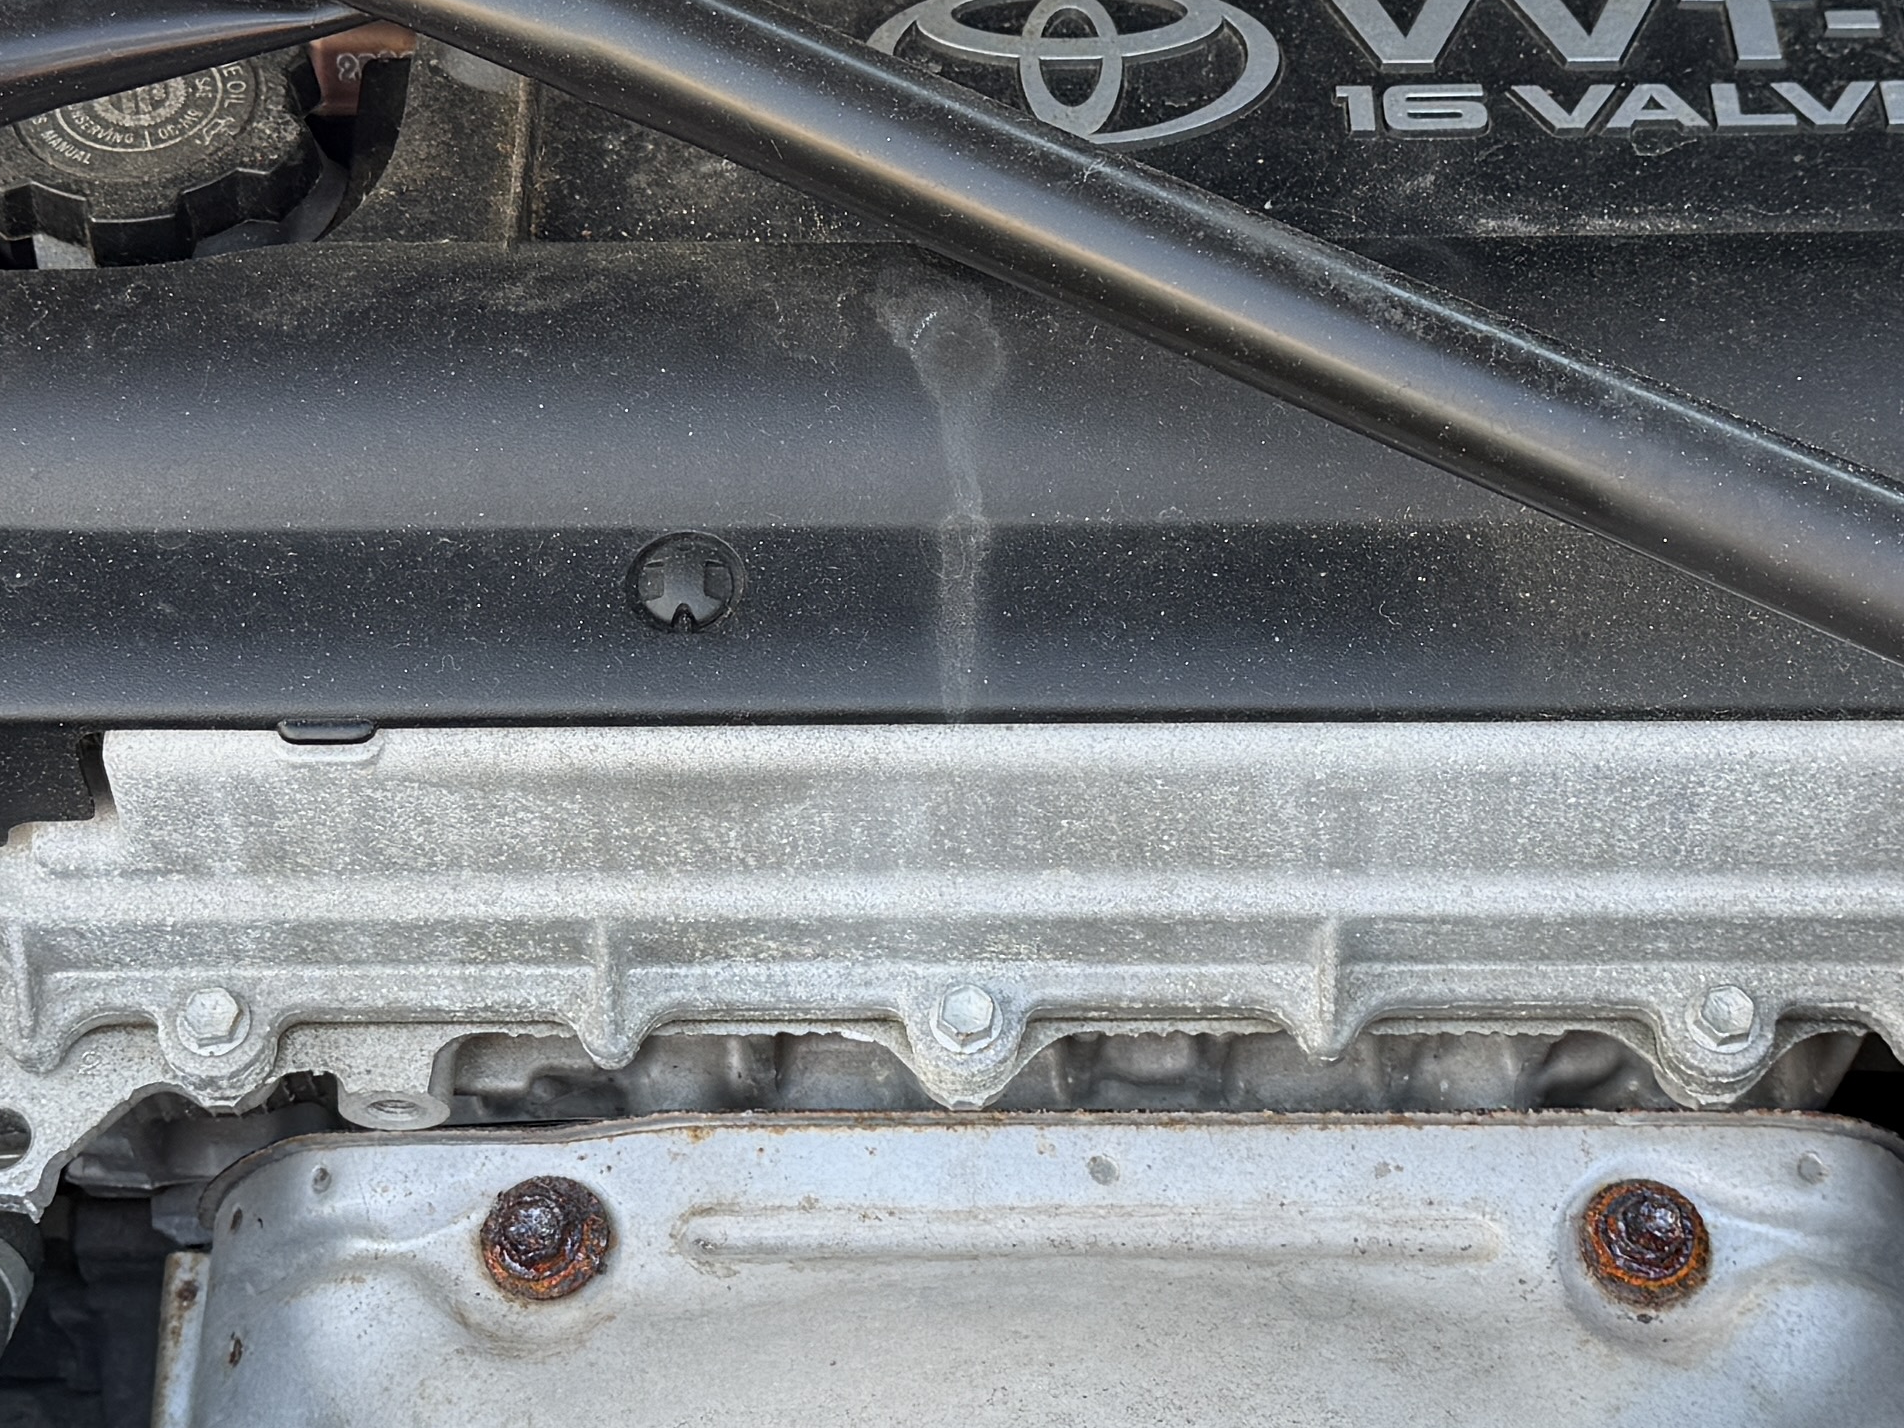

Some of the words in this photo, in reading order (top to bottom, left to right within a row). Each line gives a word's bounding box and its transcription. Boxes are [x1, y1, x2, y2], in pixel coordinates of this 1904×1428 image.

[224, 80, 247, 109] OIL
[1335, 82, 1489, 137] 16
[40, 129, 93, 165] MANUAL
